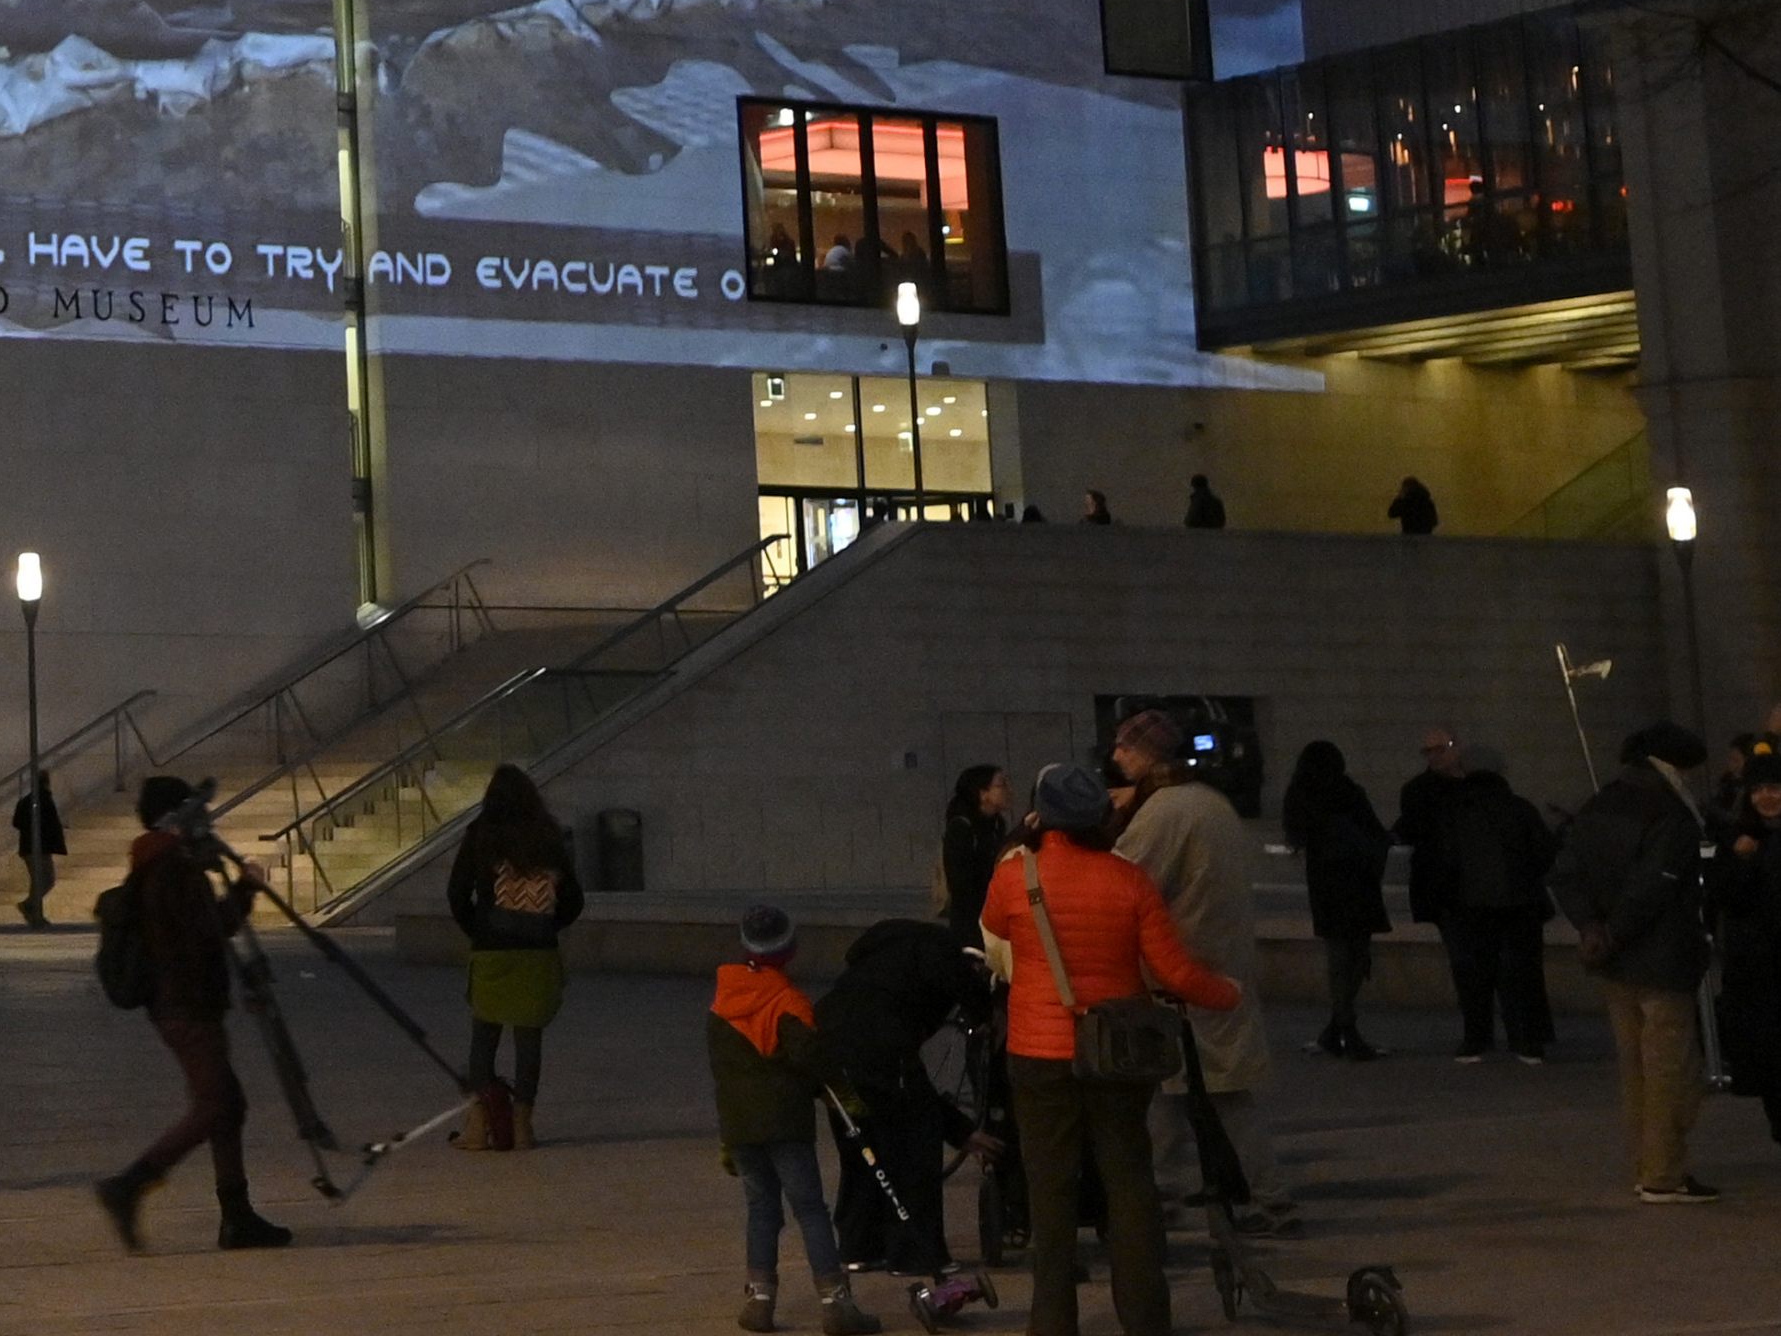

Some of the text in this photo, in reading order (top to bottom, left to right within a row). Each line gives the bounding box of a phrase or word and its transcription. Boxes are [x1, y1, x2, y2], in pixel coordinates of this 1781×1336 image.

[29, 231, 151, 270] HAVE
[175, 239, 234, 275] TO
[256, 243, 343, 294] TRY
[369, 250, 452, 286] AND
[475, 255, 699, 299] EVACUATE
[52, 286, 255, 329] MUSEUM
